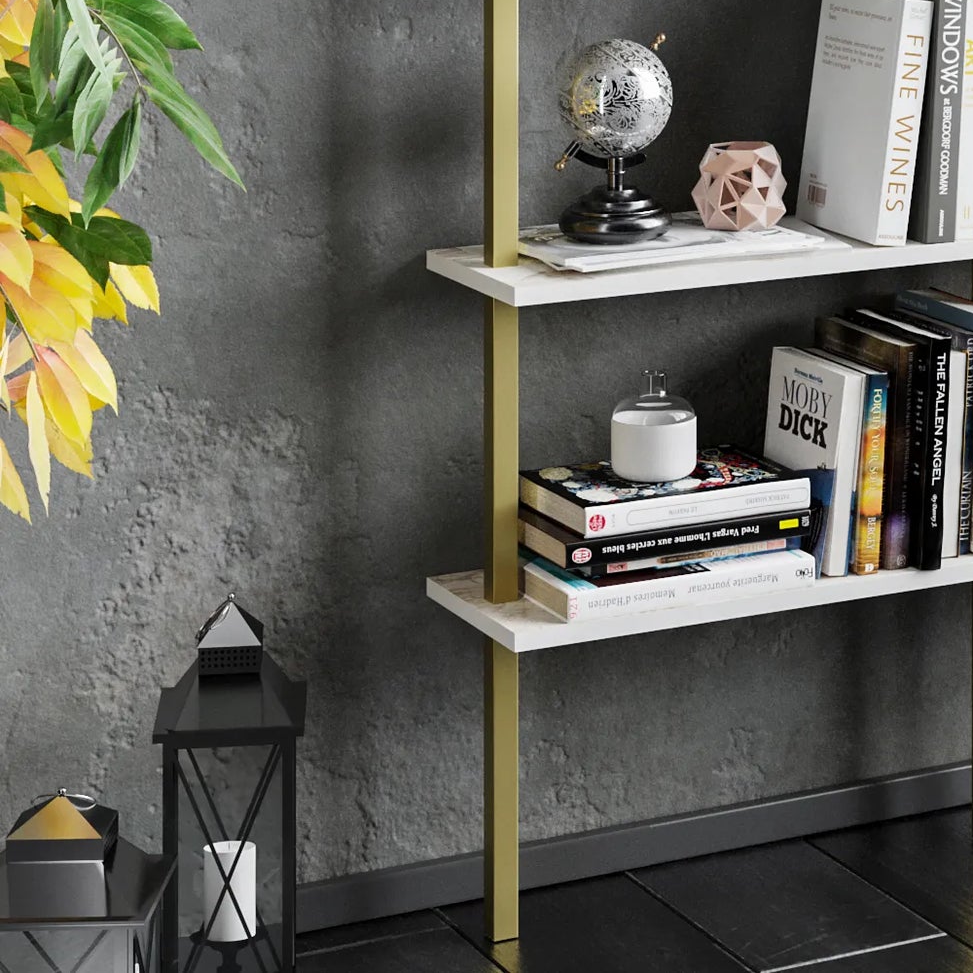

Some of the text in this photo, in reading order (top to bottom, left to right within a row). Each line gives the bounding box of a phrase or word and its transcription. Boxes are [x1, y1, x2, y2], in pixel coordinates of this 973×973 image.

[899, 34, 925, 99] FINE
[941, 106, 953, 150] BERGDORF
[885, 114, 915, 212] WINES
[939, 150, 950, 195] GOODMAN
[936, 352, 946, 381] THE
[781, 376, 832, 419] MOBY
[870, 388, 883, 430] FORTIFY
[934, 383, 945, 435] FALLEN
[778, 403, 829, 449] DICK
[868, 433, 881, 464] YOUR
[931, 438, 943, 486] ANGEL
[602, 524, 760, 555] Fred Vargas L'homme aux cercles bleus
[866, 516, 877, 550] BERGEY
[588, 587, 676, 610] Memoires d'Hadrien
[687, 572, 779, 595] Marguerite yourcenar
